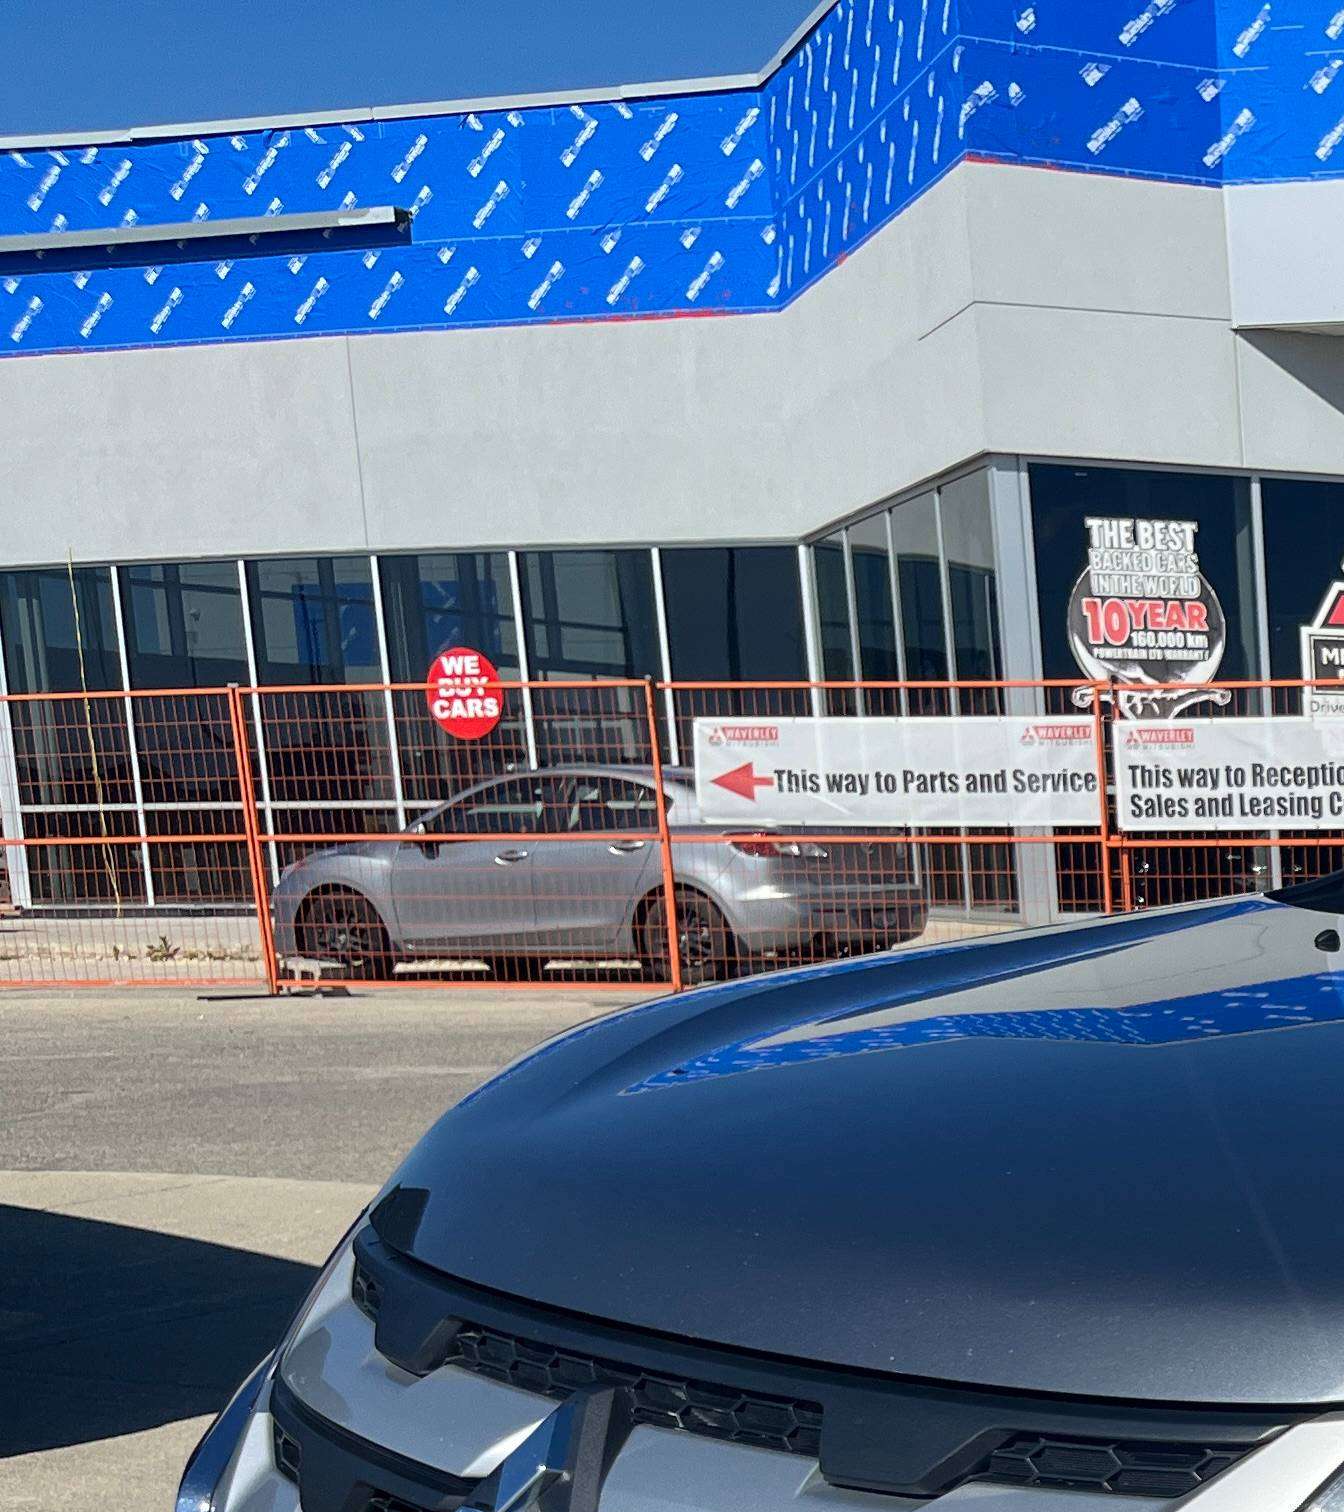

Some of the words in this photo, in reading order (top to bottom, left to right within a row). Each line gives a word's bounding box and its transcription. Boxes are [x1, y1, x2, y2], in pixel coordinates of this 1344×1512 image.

[1086, 518, 1133, 549] THE
[1137, 520, 1198, 552] BEST
[1092, 551, 1151, 571] BACKED
[1154, 554, 1199, 573] CARS
[1092, 574, 1108, 595] IN
[1109, 574, 1143, 596] THE
[1144, 576, 1199, 597] WORLD
[1083, 598, 1130, 645] 10
[1127, 600, 1209, 631] YEAR
[1132, 632, 1185, 648] 160,000
[1187, 633, 1209, 649] km
[441, 655, 481, 676] WE
[438, 676, 488, 697] BUY
[433, 697, 499, 719] CARS
[725, 727, 778, 739] WAVERLEY
[1038, 727, 1091, 739] WAVERLEY
[1141, 729, 1193, 742] WAVERLEY
[774, 769, 820, 793] This
[825, 771, 870, 796] way
[875, 770, 897, 793] to
[903, 769, 960, 794] Parts
[965, 768, 1008, 793] and
[1012, 768, 1098, 793] Service
[1128, 765, 1173, 788] This
[1176, 768, 1220, 793] way
[1224, 765, 1246, 788] to
[1130, 793, 1188, 818] Sales
[1194, 792, 1233, 817] and
[1239, 791, 1321, 818] Leasing
